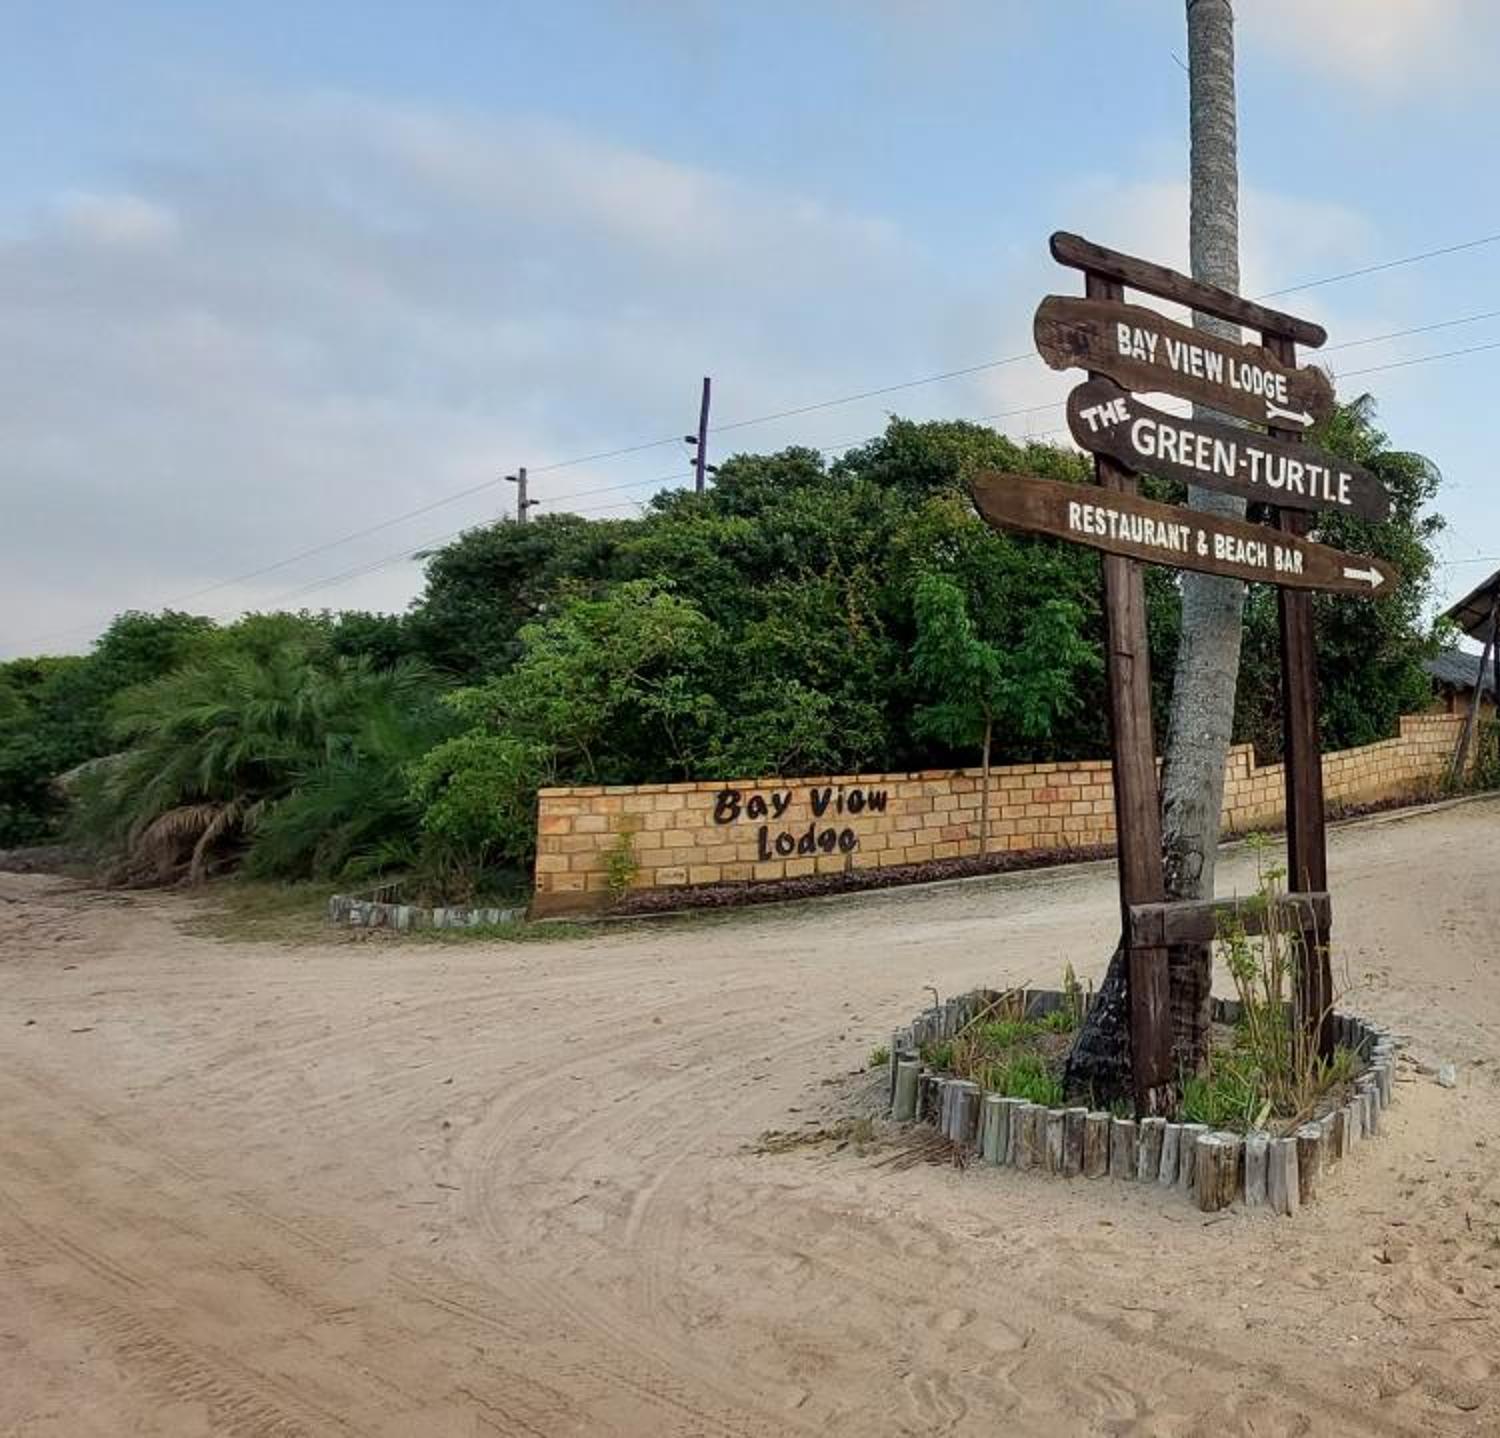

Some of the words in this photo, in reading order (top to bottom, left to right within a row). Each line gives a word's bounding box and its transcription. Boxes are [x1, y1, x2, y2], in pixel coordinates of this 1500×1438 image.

[1117, 323, 1158, 363] BAY
[1166, 338, 1223, 384] VIEW
[1229, 358, 1289, 404] LODGE
[1080, 399, 1130, 433] THE
[1131, 419, 1353, 505] GREEN-TURTLE
[1069, 502, 1190, 553] RESTAURANT
[1197, 532, 1209, 556] &
[1215, 535, 1267, 568] BEACH
[1274, 549, 1303, 575] BAR
[713, 789, 792, 825] Bay
[810, 786, 888, 817] View
[758, 823, 857, 861] Lodge
